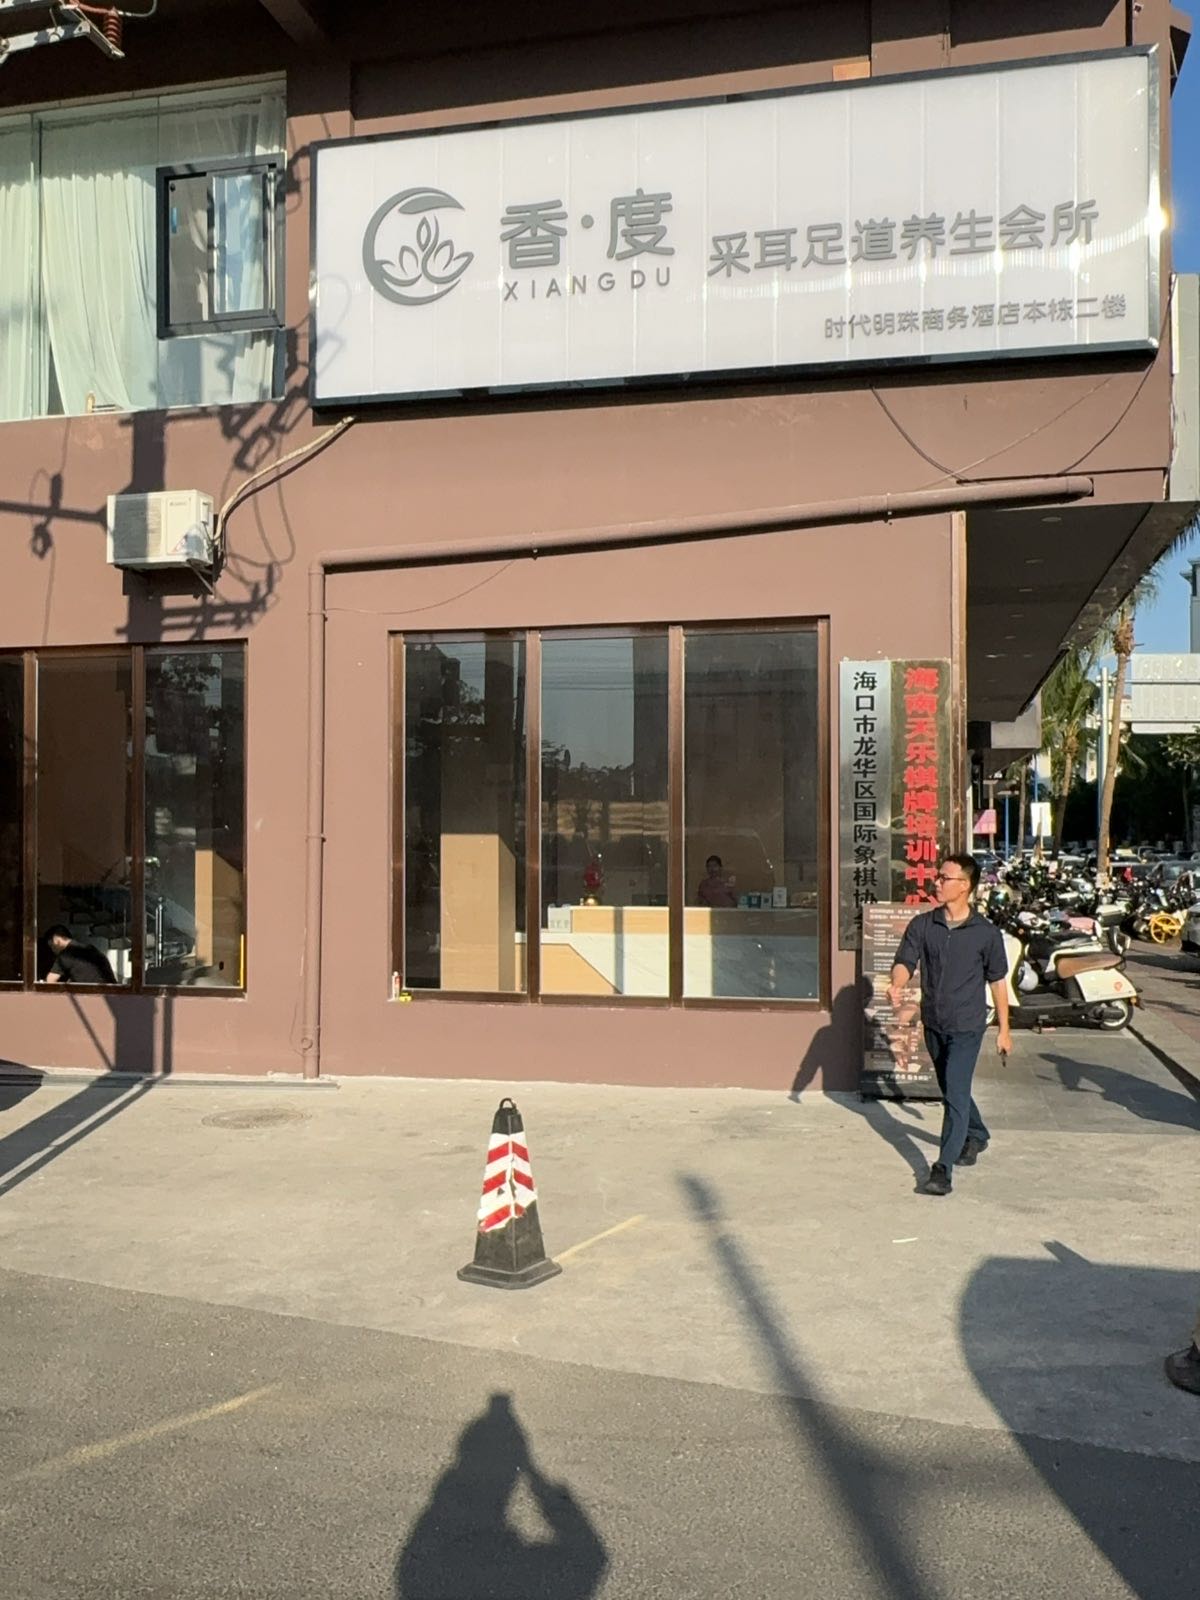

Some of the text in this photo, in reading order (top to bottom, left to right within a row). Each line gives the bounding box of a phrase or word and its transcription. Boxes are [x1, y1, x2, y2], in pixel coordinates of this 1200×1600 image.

[707, 199, 1099, 278] 采耳足道养生会所
[824, 294, 1127, 340] 时代明珠商务酒店本栋二楼
